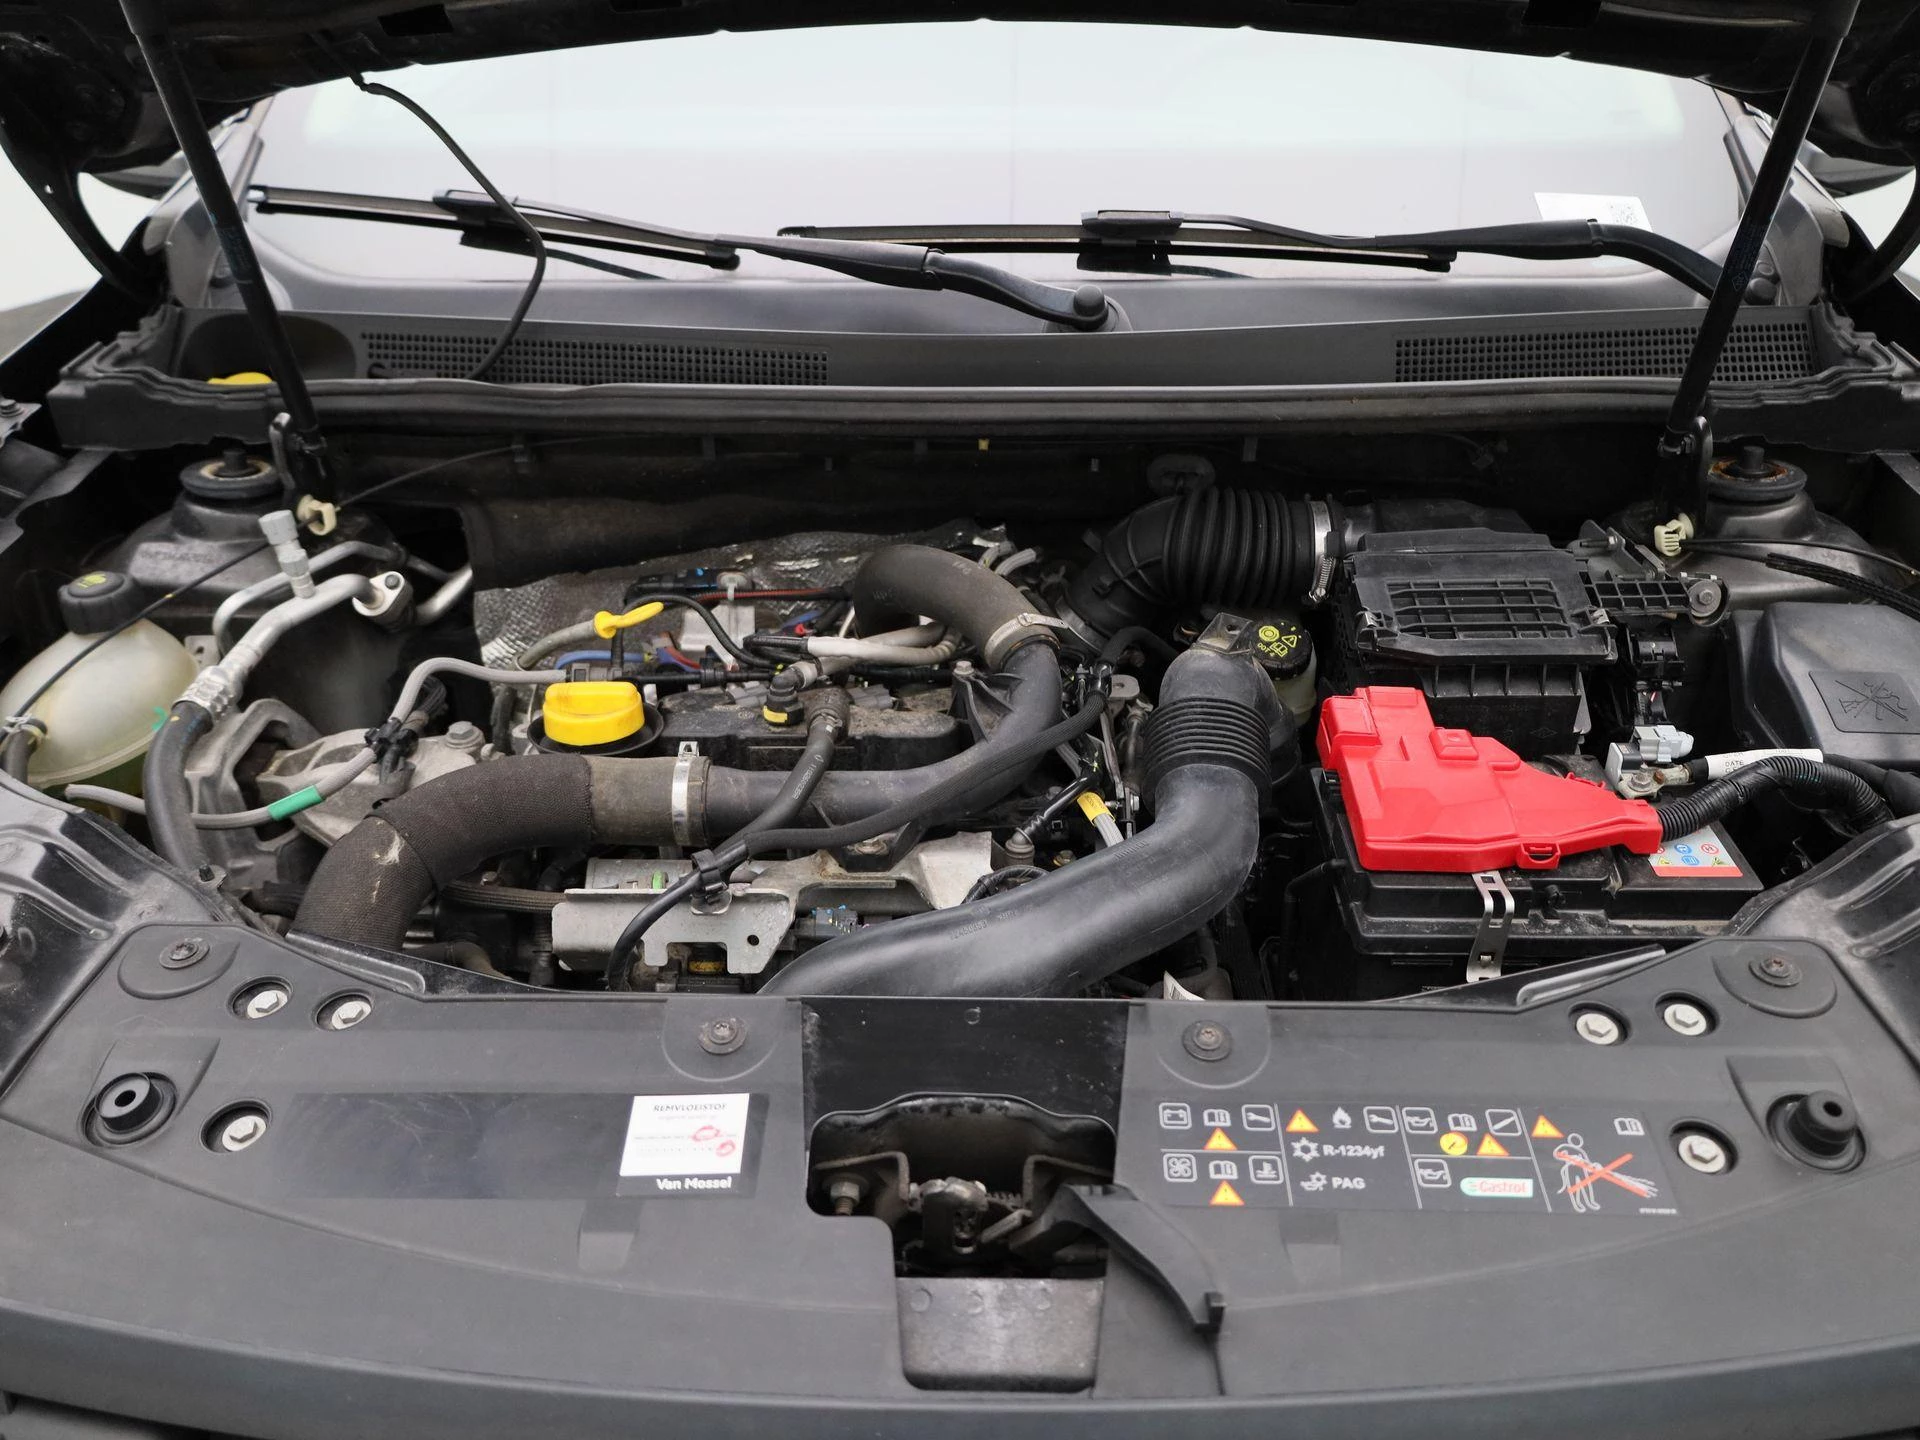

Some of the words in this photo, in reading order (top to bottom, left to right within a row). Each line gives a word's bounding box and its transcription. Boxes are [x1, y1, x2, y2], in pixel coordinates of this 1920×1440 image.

[1322, 1144, 1385, 1160] R-1234yf
[656, 1178, 682, 1190] Van
[684, 1175, 733, 1190] Mossel
[1331, 1176, 1366, 1190] PAG
[1480, 1181, 1526, 1193] Castrol
